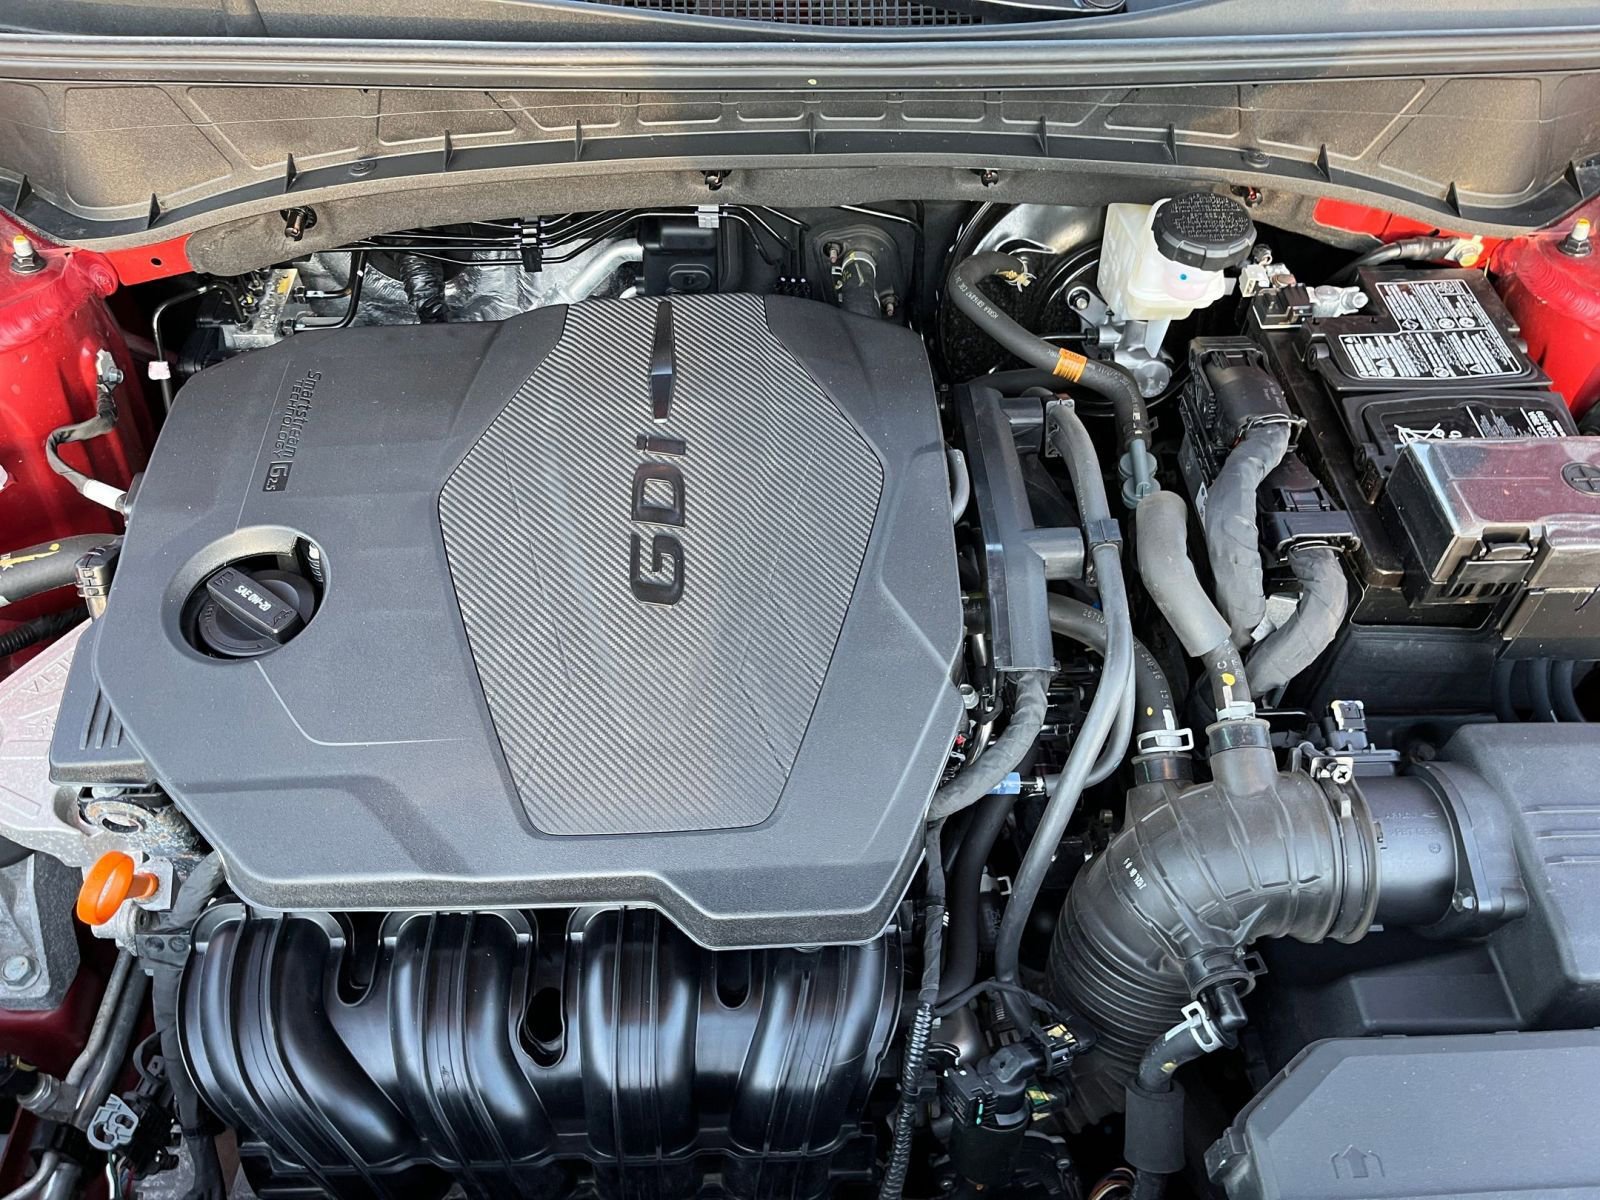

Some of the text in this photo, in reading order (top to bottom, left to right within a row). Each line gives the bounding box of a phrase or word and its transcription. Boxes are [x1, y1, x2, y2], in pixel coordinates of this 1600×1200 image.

[273, 379, 304, 458] TECHNOLOGY
[283, 369, 322, 458] Smartstream
[630, 434, 686, 608] GDi
[234, 585, 272, 611] SAE 0W-20
